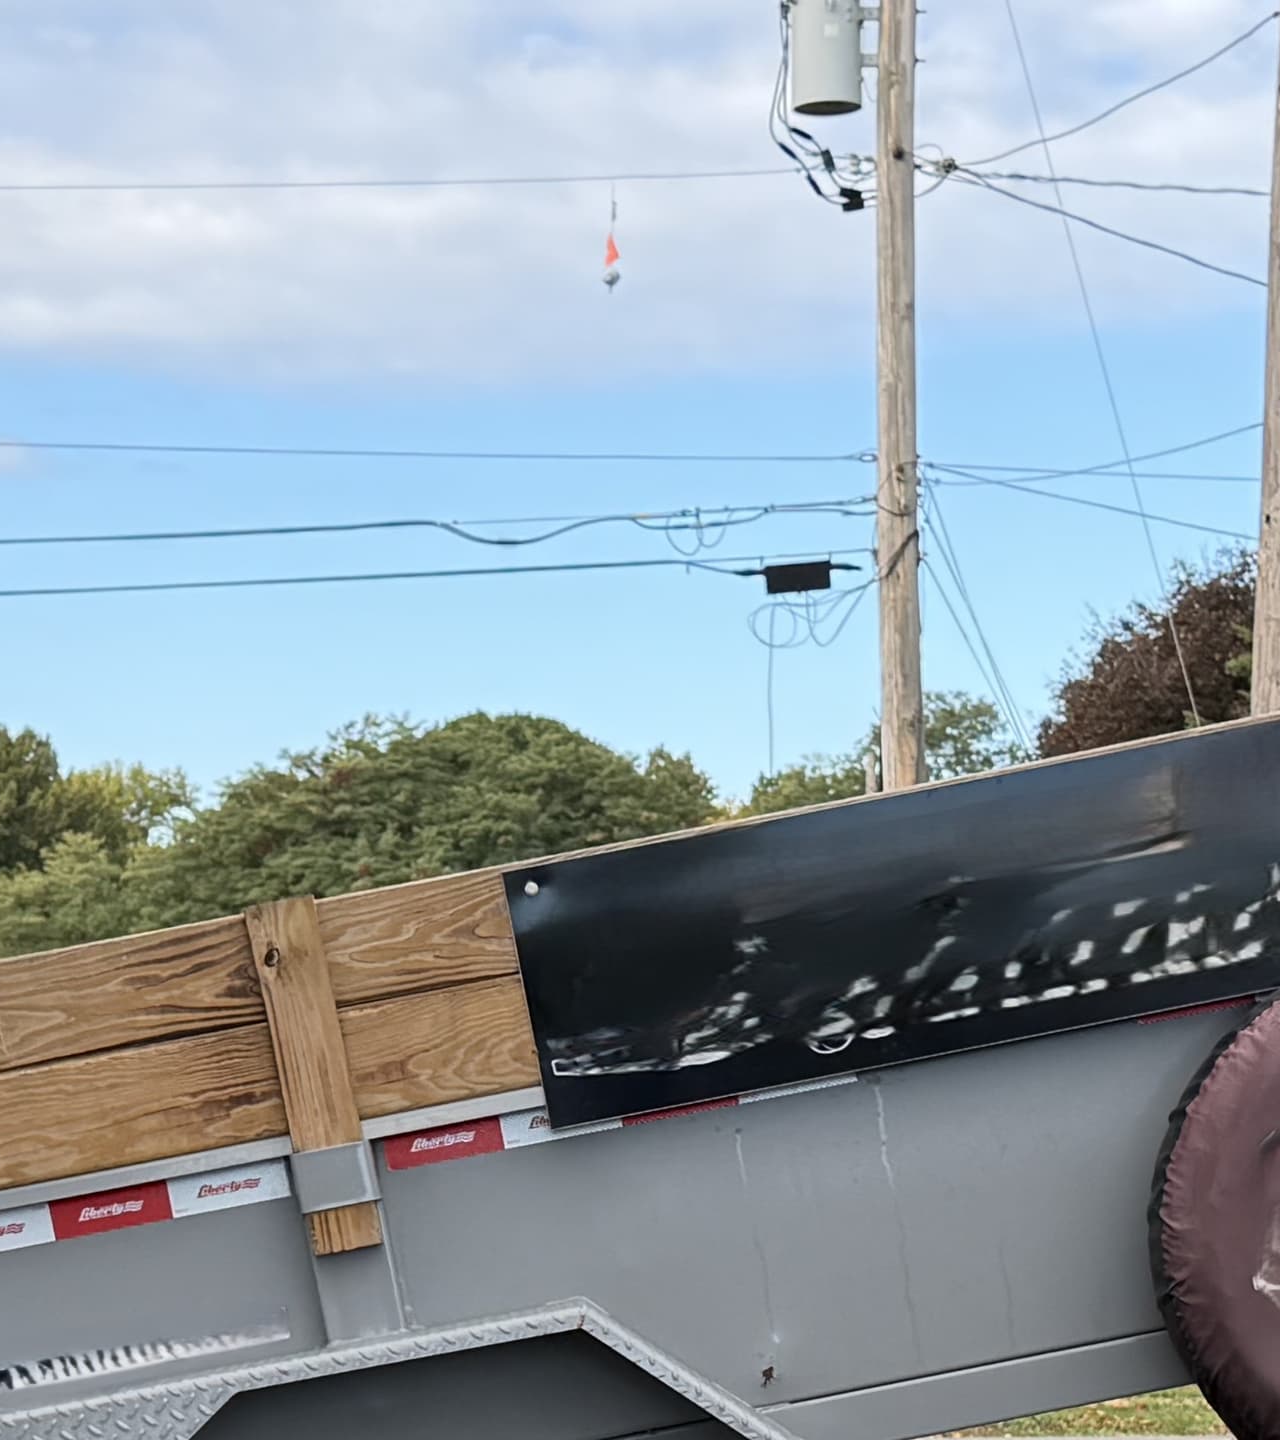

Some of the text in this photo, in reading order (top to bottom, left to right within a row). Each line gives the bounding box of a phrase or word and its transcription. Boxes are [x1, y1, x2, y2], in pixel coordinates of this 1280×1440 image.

[410, 1133, 457, 1152] Liberty
[196, 1180, 244, 1199] Liberty
[78, 1201, 126, 1221] Liberty
